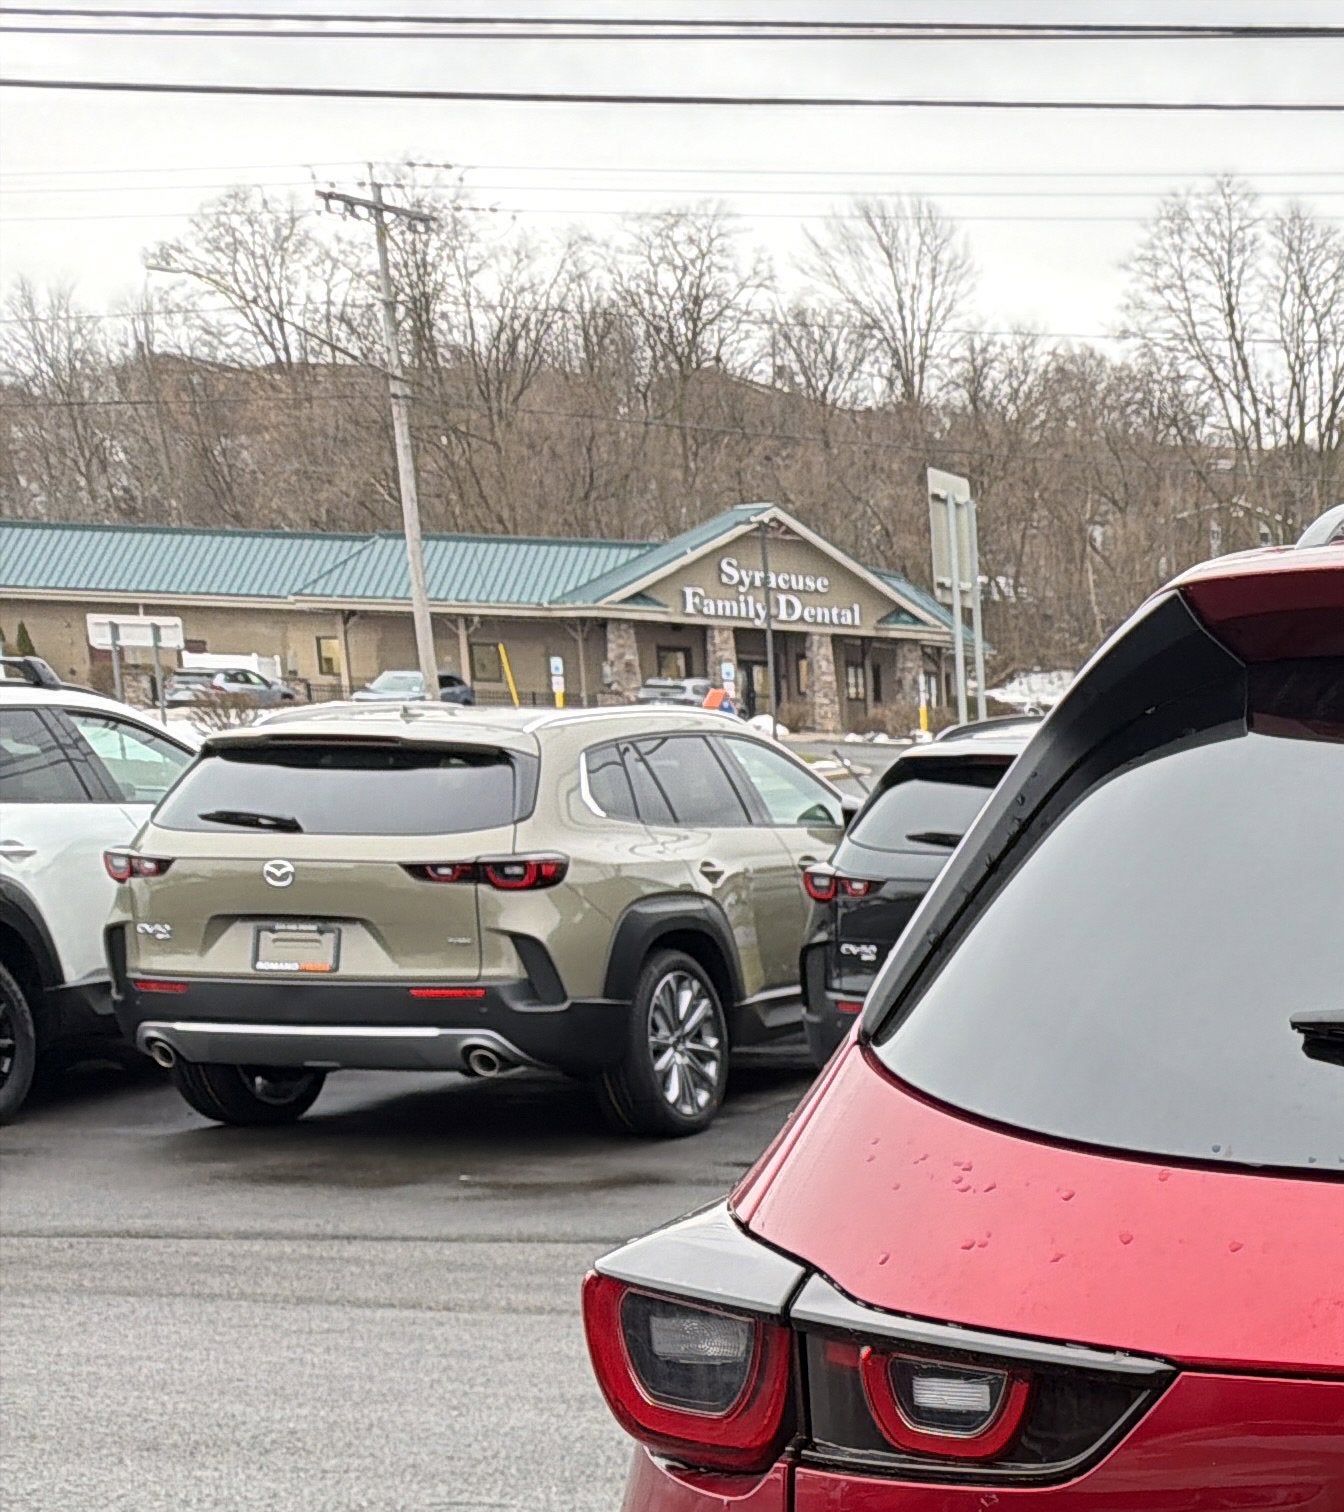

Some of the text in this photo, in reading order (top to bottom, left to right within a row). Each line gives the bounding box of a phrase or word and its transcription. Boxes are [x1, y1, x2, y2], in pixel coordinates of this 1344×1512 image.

[720, 557, 829, 593] Syracuse
[683, 586, 860, 626] Family Dental
